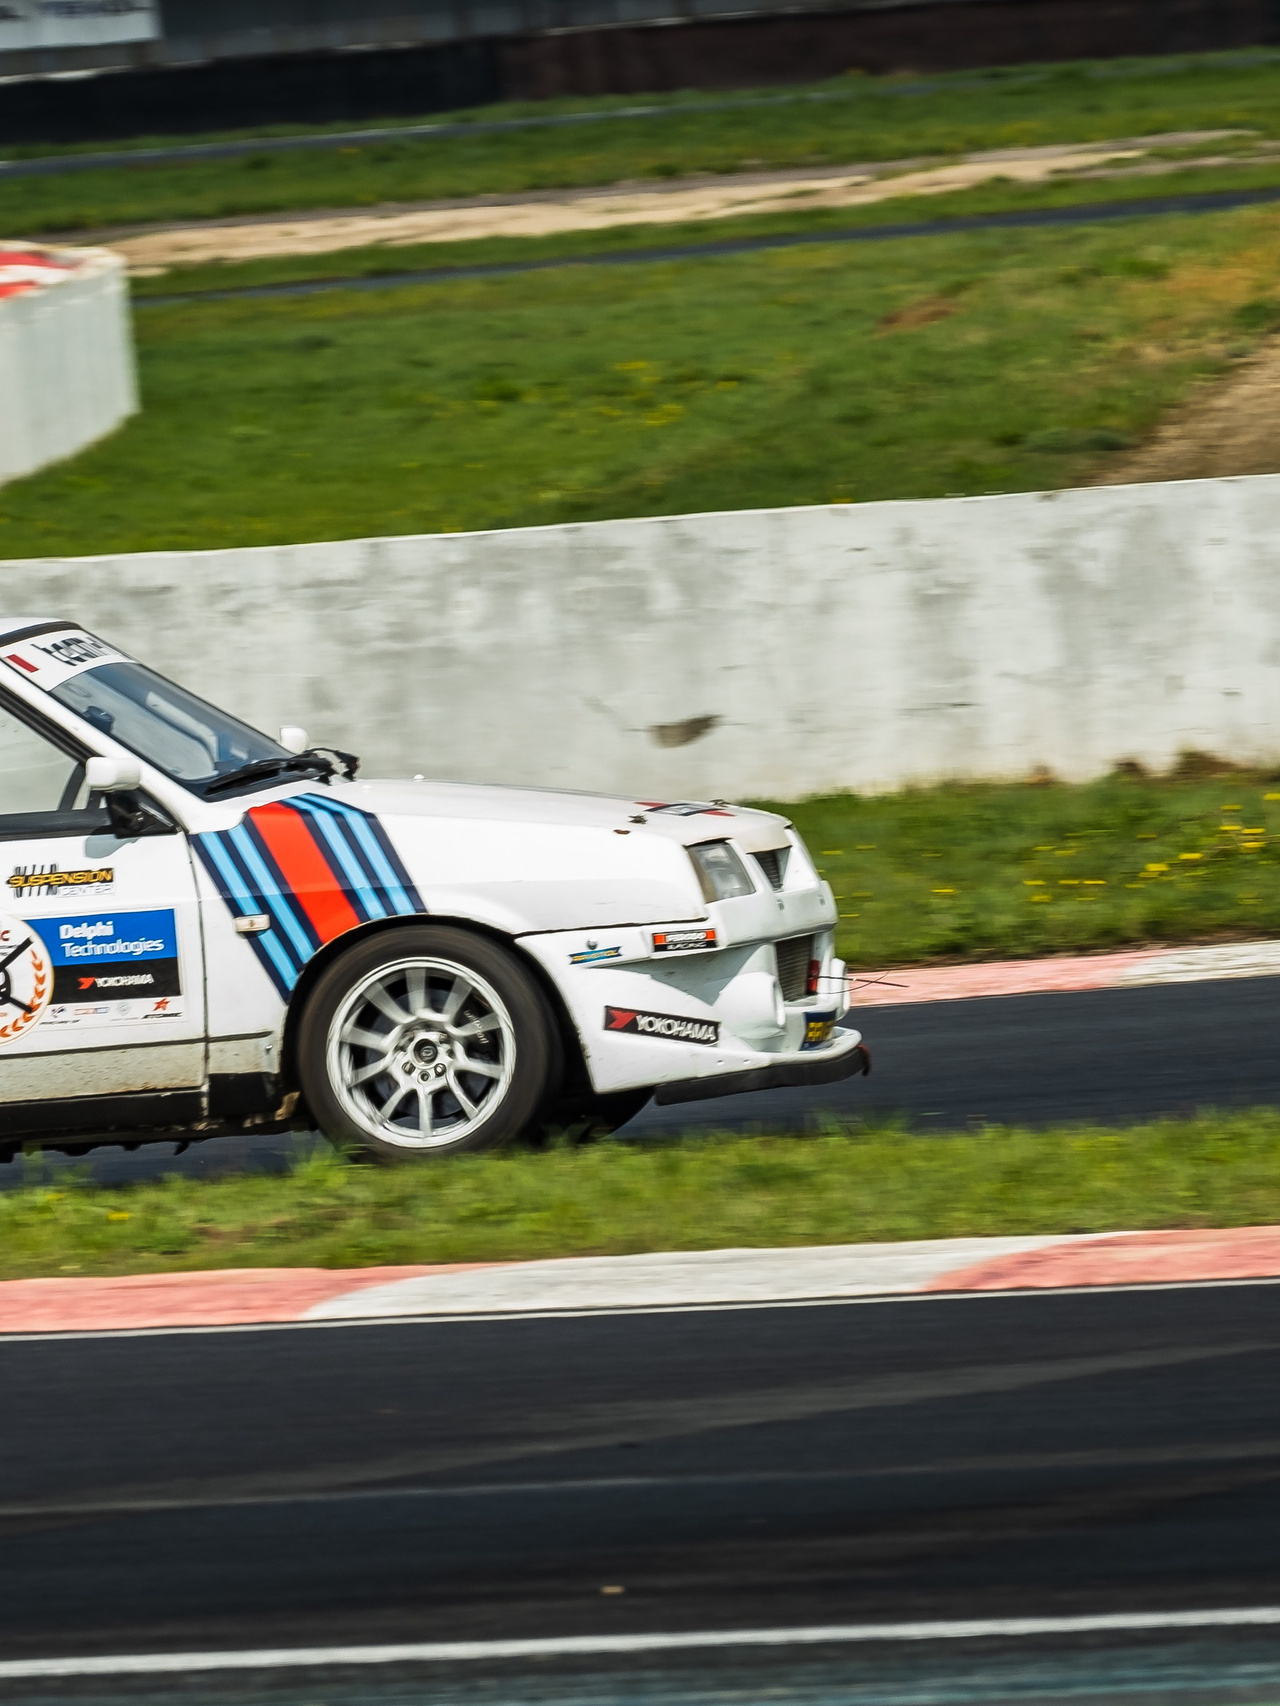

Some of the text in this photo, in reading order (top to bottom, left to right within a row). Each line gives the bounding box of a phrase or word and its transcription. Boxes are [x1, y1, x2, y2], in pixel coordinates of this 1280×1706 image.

[9, 869, 113, 888] SUSPENSION
[59, 920, 114, 940] Delphi
[60, 937, 165, 958] Technologies
[636, 1014, 717, 1041] YOKOHAMA
